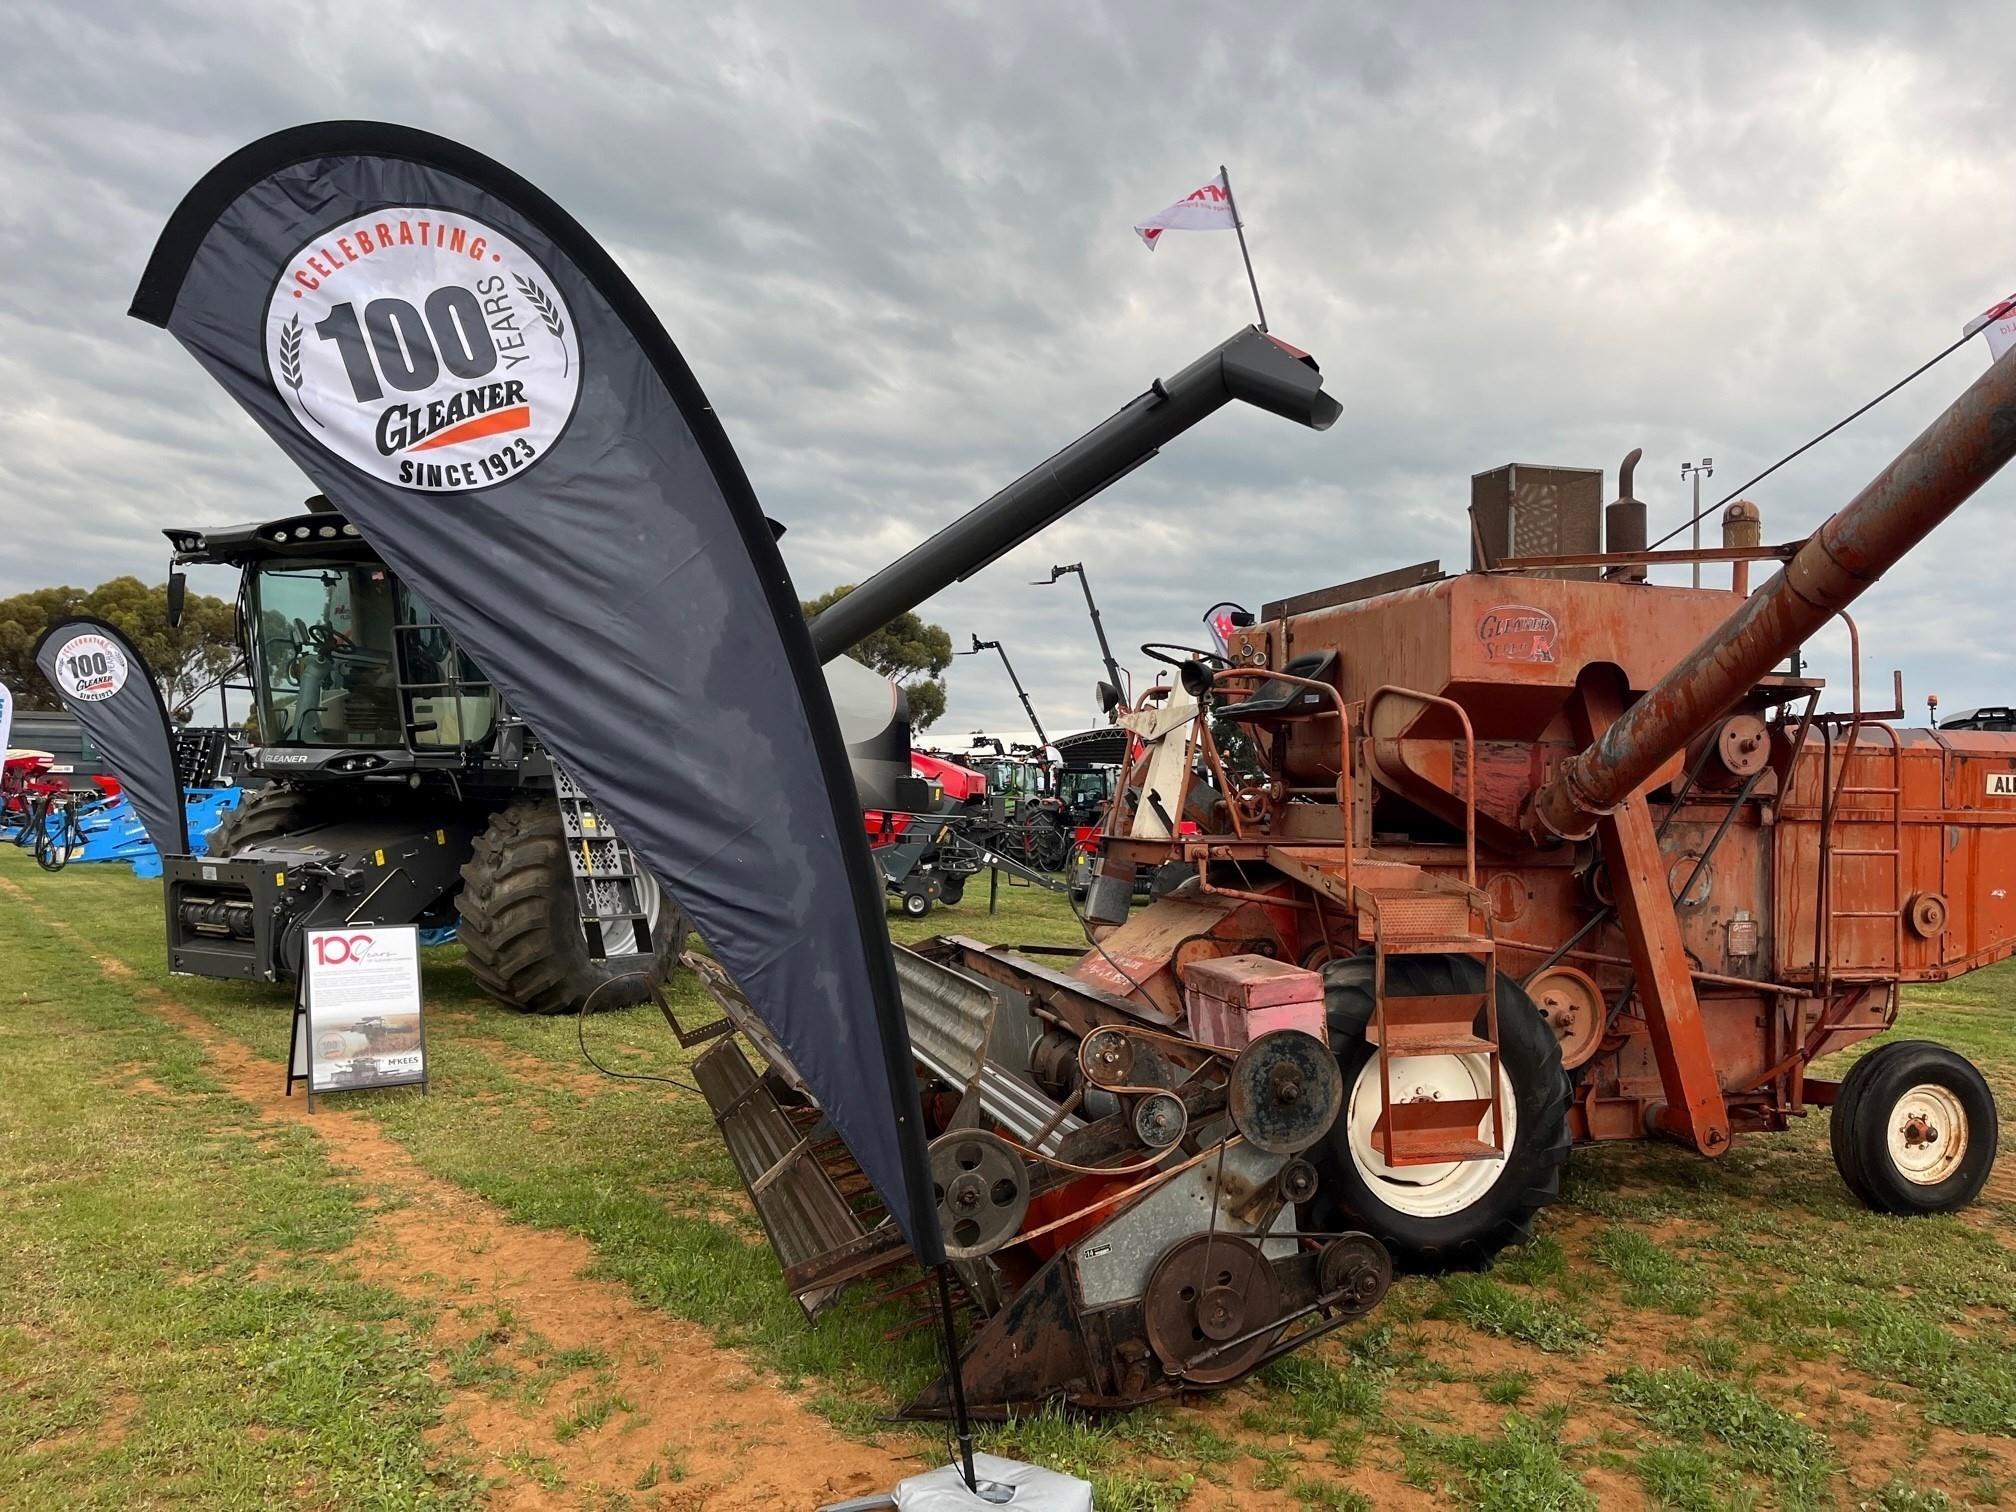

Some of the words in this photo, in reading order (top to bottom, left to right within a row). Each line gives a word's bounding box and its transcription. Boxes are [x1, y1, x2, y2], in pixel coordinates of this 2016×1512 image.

[295, 220, 488, 291] CELEBRATING
[477, 275, 530, 370] YEARS
[315, 286, 497, 403] 100
[376, 380, 528, 457] GLEANER
[399, 460, 477, 488] SINCE
[479, 437, 536, 482] 1923
[67, 653, 108, 679] 100
[76, 676, 113, 691] GLEANER
[80, 692, 98, 700] SINCE
[99, 690, 113, 699] 1923
[265, 754, 308, 763] GLEANER
[313, 935, 373, 966] 100
